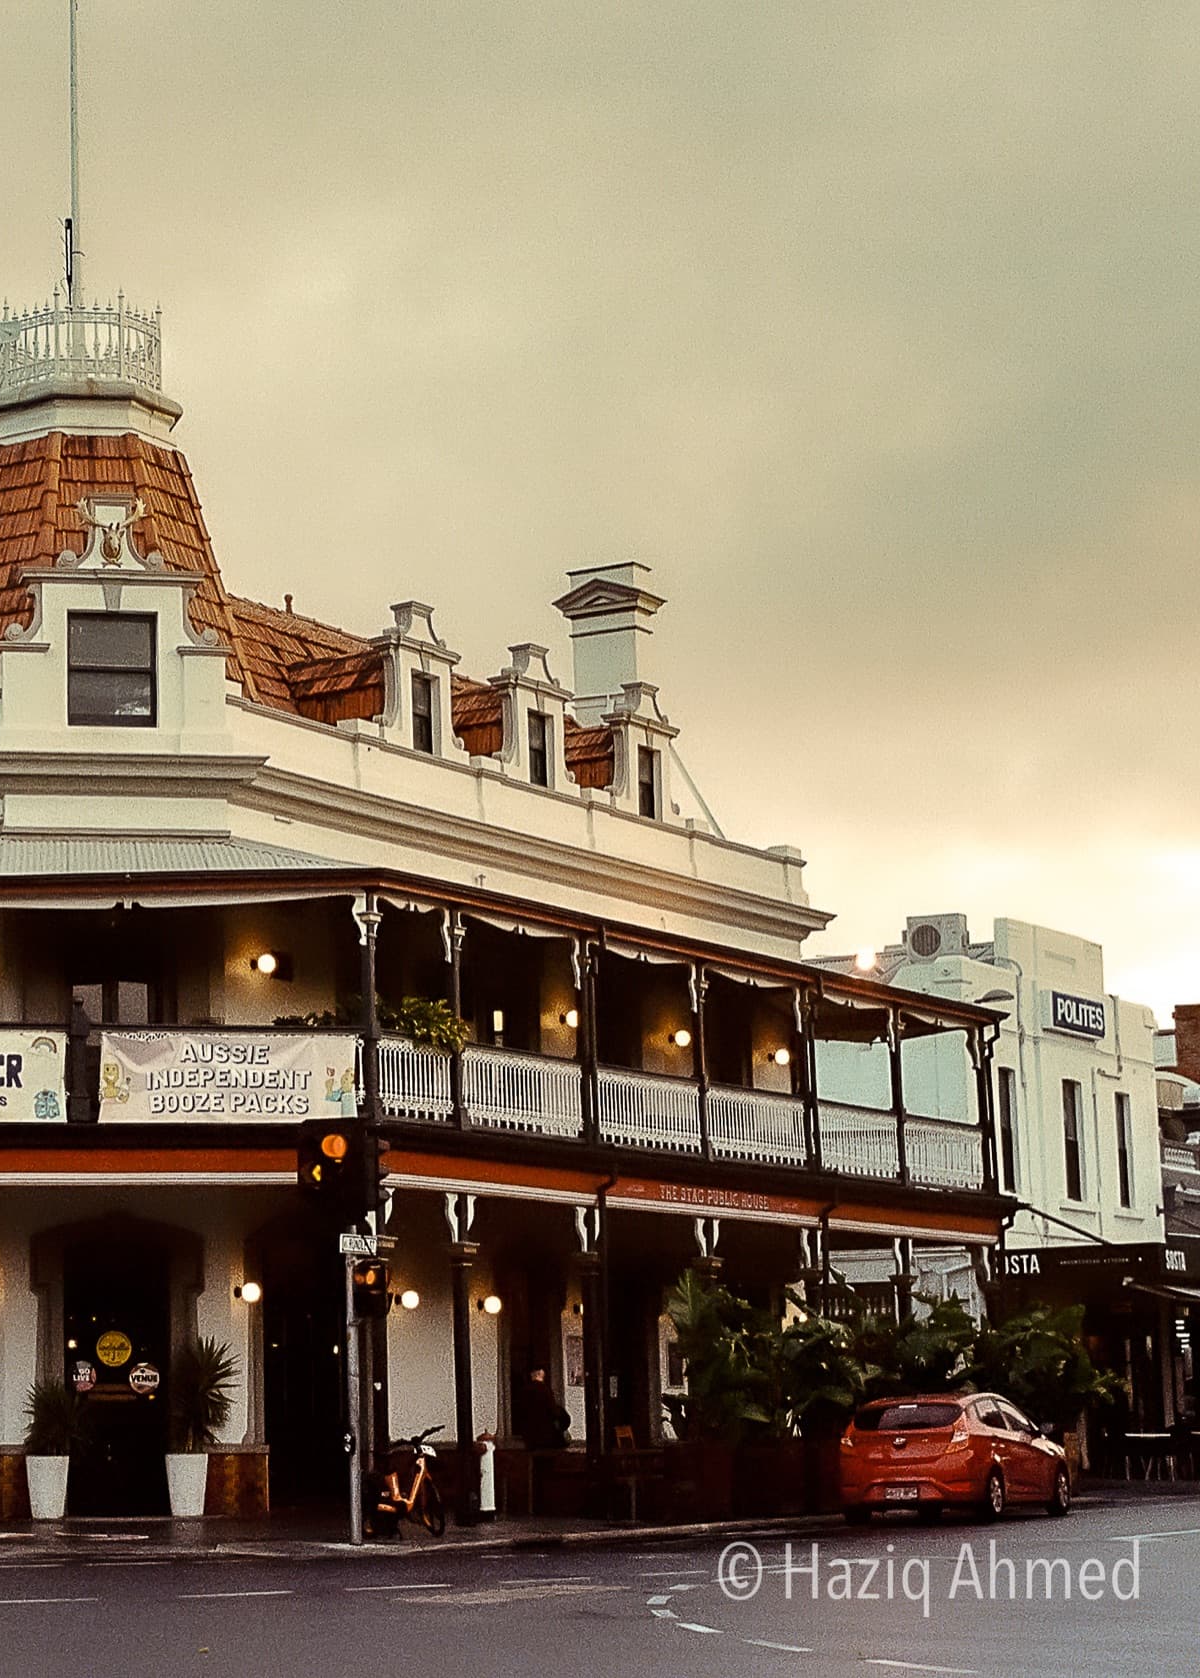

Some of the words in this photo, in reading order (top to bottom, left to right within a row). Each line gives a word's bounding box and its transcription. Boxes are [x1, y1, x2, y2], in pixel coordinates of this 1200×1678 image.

[1057, 998, 1103, 1030] POLITES
[180, 1042, 270, 1065] AUSSIE
[146, 1067, 312, 1090] INDEPENDENT
[150, 1092, 225, 1114] BOOZE
[230, 1092, 309, 1115] PACKS
[659, 1184, 678, 1201] THE
[707, 1189, 739, 1208] PUBLIC
[741, 1193, 769, 1210] HOUSE
[995, 1254, 1041, 1275] STA
[1165, 1249, 1186, 1271] SOSTA
[131, 1374, 158, 1382] VENUE
